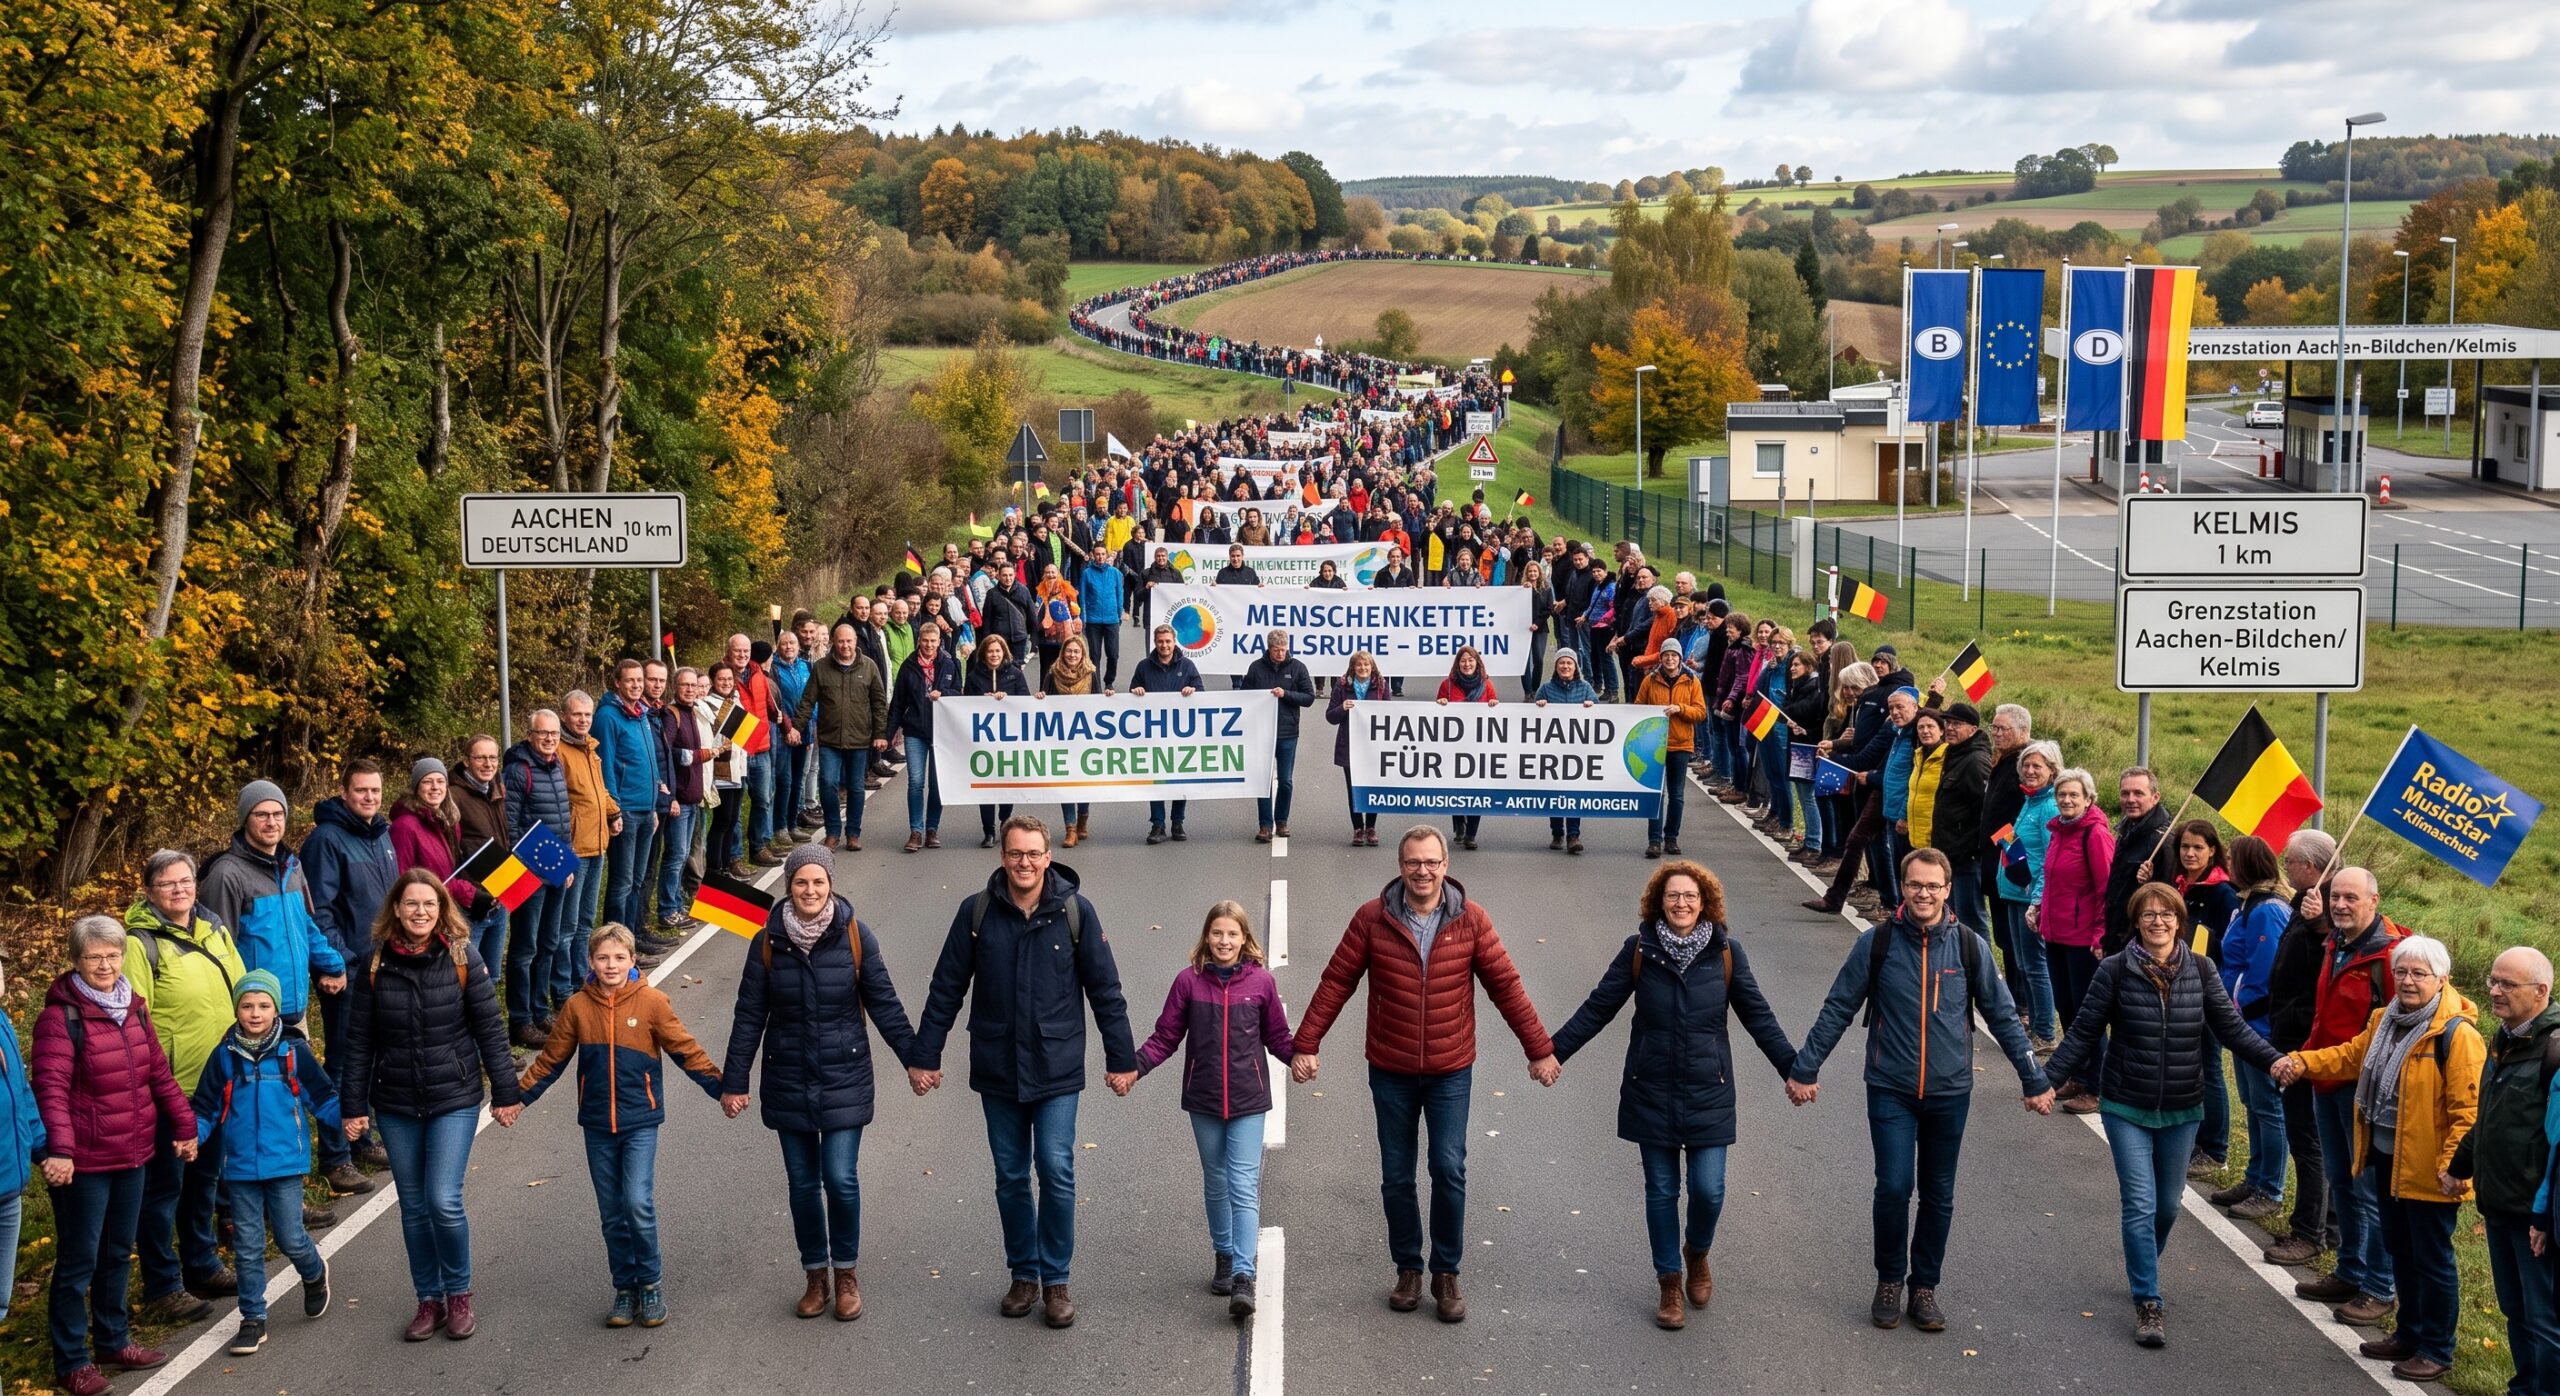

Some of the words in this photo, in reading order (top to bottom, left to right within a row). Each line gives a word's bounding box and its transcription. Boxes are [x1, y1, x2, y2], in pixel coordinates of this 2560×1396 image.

[1932, 333, 1948, 352] B
[2092, 336, 2109, 357] D
[2297, 336, 2517, 355] Aachen-Bildchen/Kelmis
[511, 508, 612, 529] AACHEN
[624, 521, 640, 536] 10
[646, 521, 672, 537] km
[2194, 511, 2298, 535] KELMIS
[482, 536, 628, 554] DEUTSCHLAND
[2218, 545, 2225, 565] 1
[2236, 544, 2272, 565] km
[1246, 604, 1495, 628] MENSCHENKETTE:
[2168, 600, 2316, 621] Grenzstation
[1232, 633, 1389, 656] KALSRUHE
[2135, 628, 2347, 649] Aachen-Bildchen/
[2200, 656, 2281, 677] Kelmis
[972, 707, 1243, 743] KLIMASCHUTZ
[1370, 714, 1465, 743] HAND
[1476, 716, 1509, 744] IN
[1520, 717, 1615, 745] HAND
[969, 748, 1070, 778] OHNE
[1080, 744, 1245, 776] GRENZEN
[1381, 745, 1443, 779] FÜR
[1454, 752, 1508, 779] DIE
[1518, 753, 1604, 781] ERDE
[2412, 761, 2482, 815] Radio
[1368, 793, 1411, 807] RADIO
[1414, 795, 1492, 808] MUSICSTAR
[1505, 796, 1547, 809] AKTIV
[1549, 795, 1577, 810] FÜR
[1580, 798, 1639, 811] MORGEN
[2401, 785, 2491, 845] MusicStar
[2402, 808, 2480, 861] Klimaschutz
